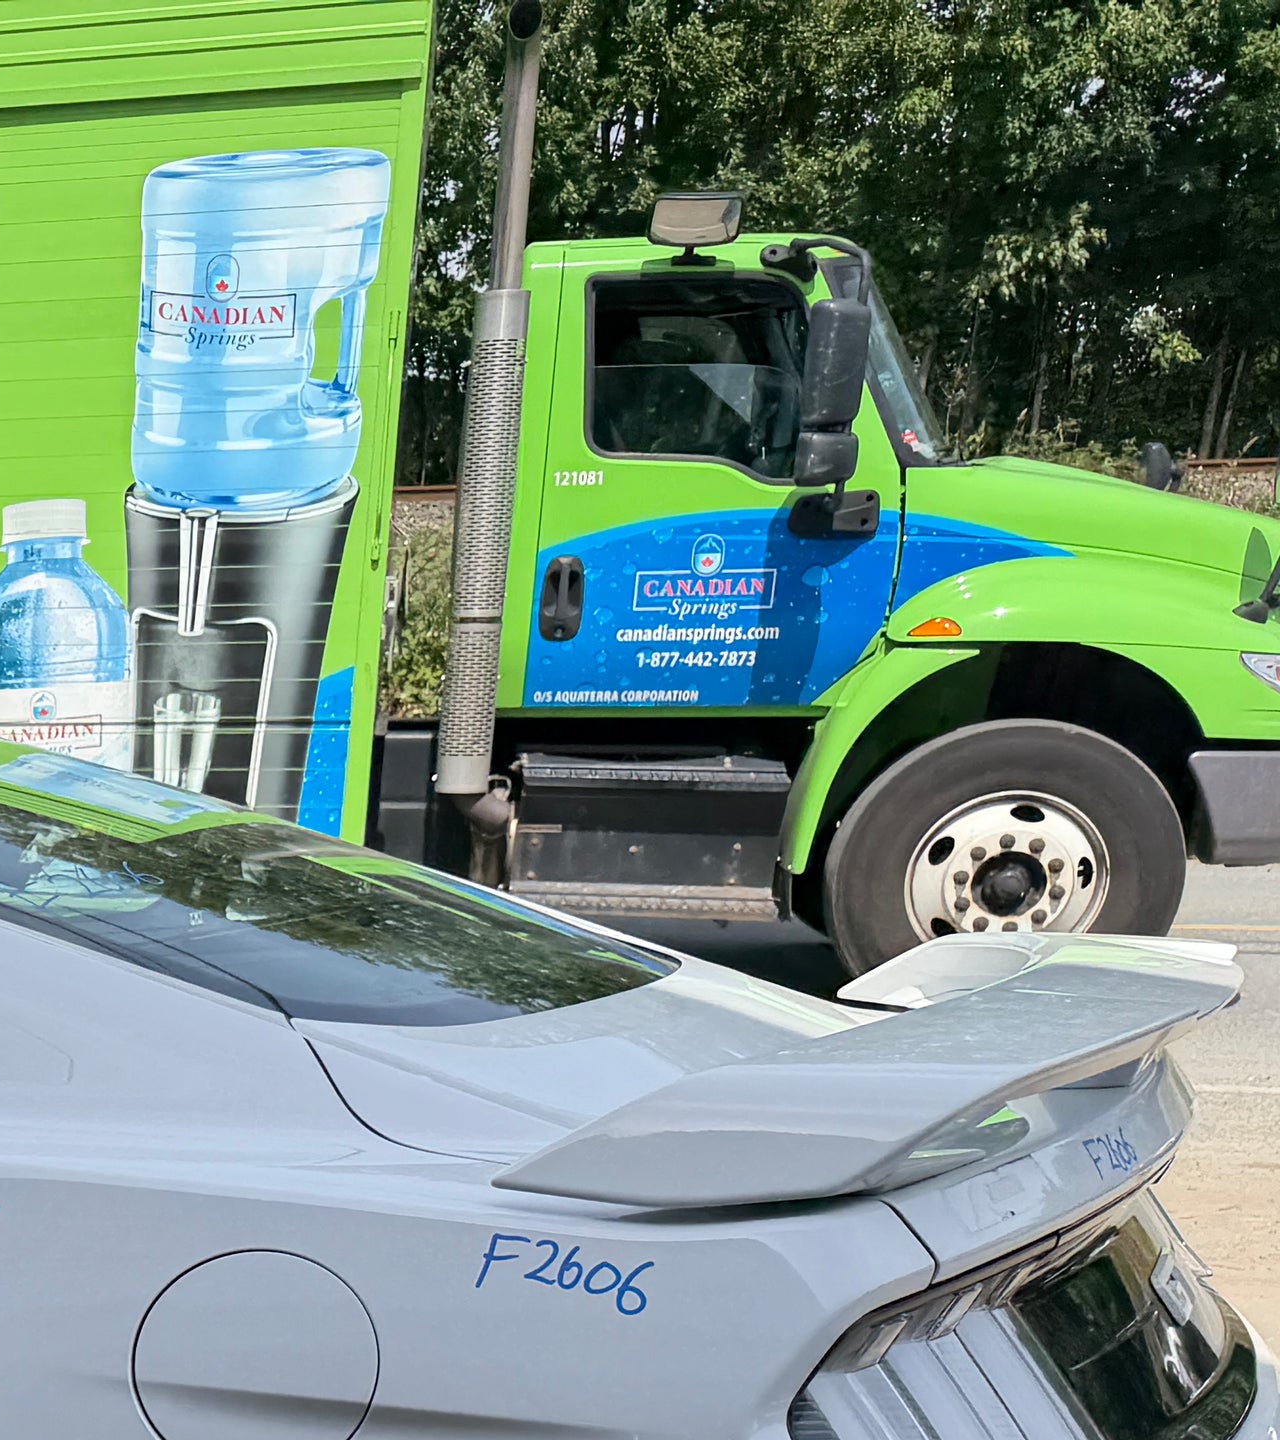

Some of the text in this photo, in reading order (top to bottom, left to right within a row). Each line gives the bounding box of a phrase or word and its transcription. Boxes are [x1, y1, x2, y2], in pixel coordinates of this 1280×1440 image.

[158, 302, 287, 325] CANADIAN
[184, 327, 256, 351] Springs
[553, 470, 604, 487] 121081
[643, 577, 767, 598] CANADIAN
[667, 599, 739, 621] Springs
[616, 624, 781, 644] canadiansprings.com
[636, 650, 757, 668] 1-877-442-7873
[533, 690, 699, 703] O/S AQUATERRA CORPORATION
[1082, 1126, 1138, 1181] F2606
[475, 1233, 653, 1316] F2606
